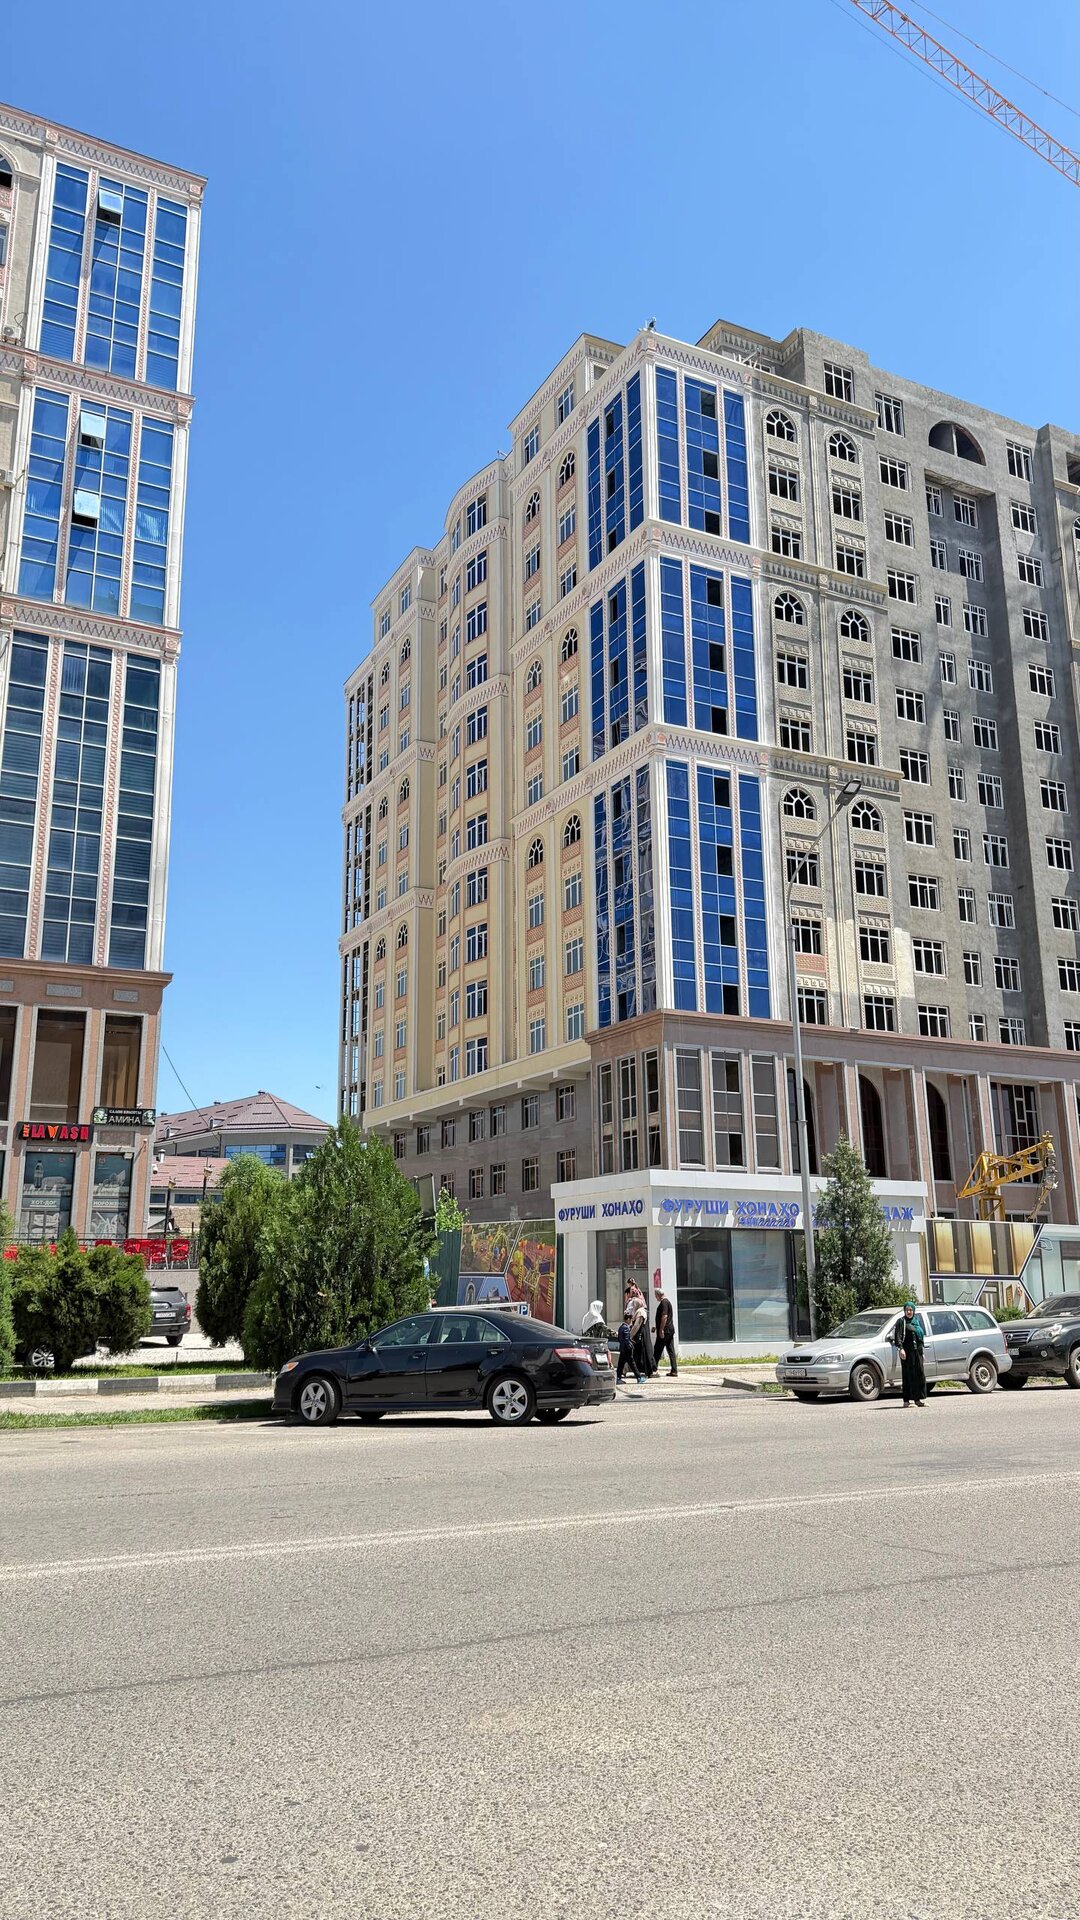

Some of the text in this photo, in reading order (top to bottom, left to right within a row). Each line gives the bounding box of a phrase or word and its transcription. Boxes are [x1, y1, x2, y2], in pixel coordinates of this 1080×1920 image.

[108, 1116, 140, 1124] АМИНА
[661, 1198, 729, 1215] ФУРУШИ
[558, 1205, 596, 1221] ФУРУШИ
[521, 1306, 528, 1315] P
